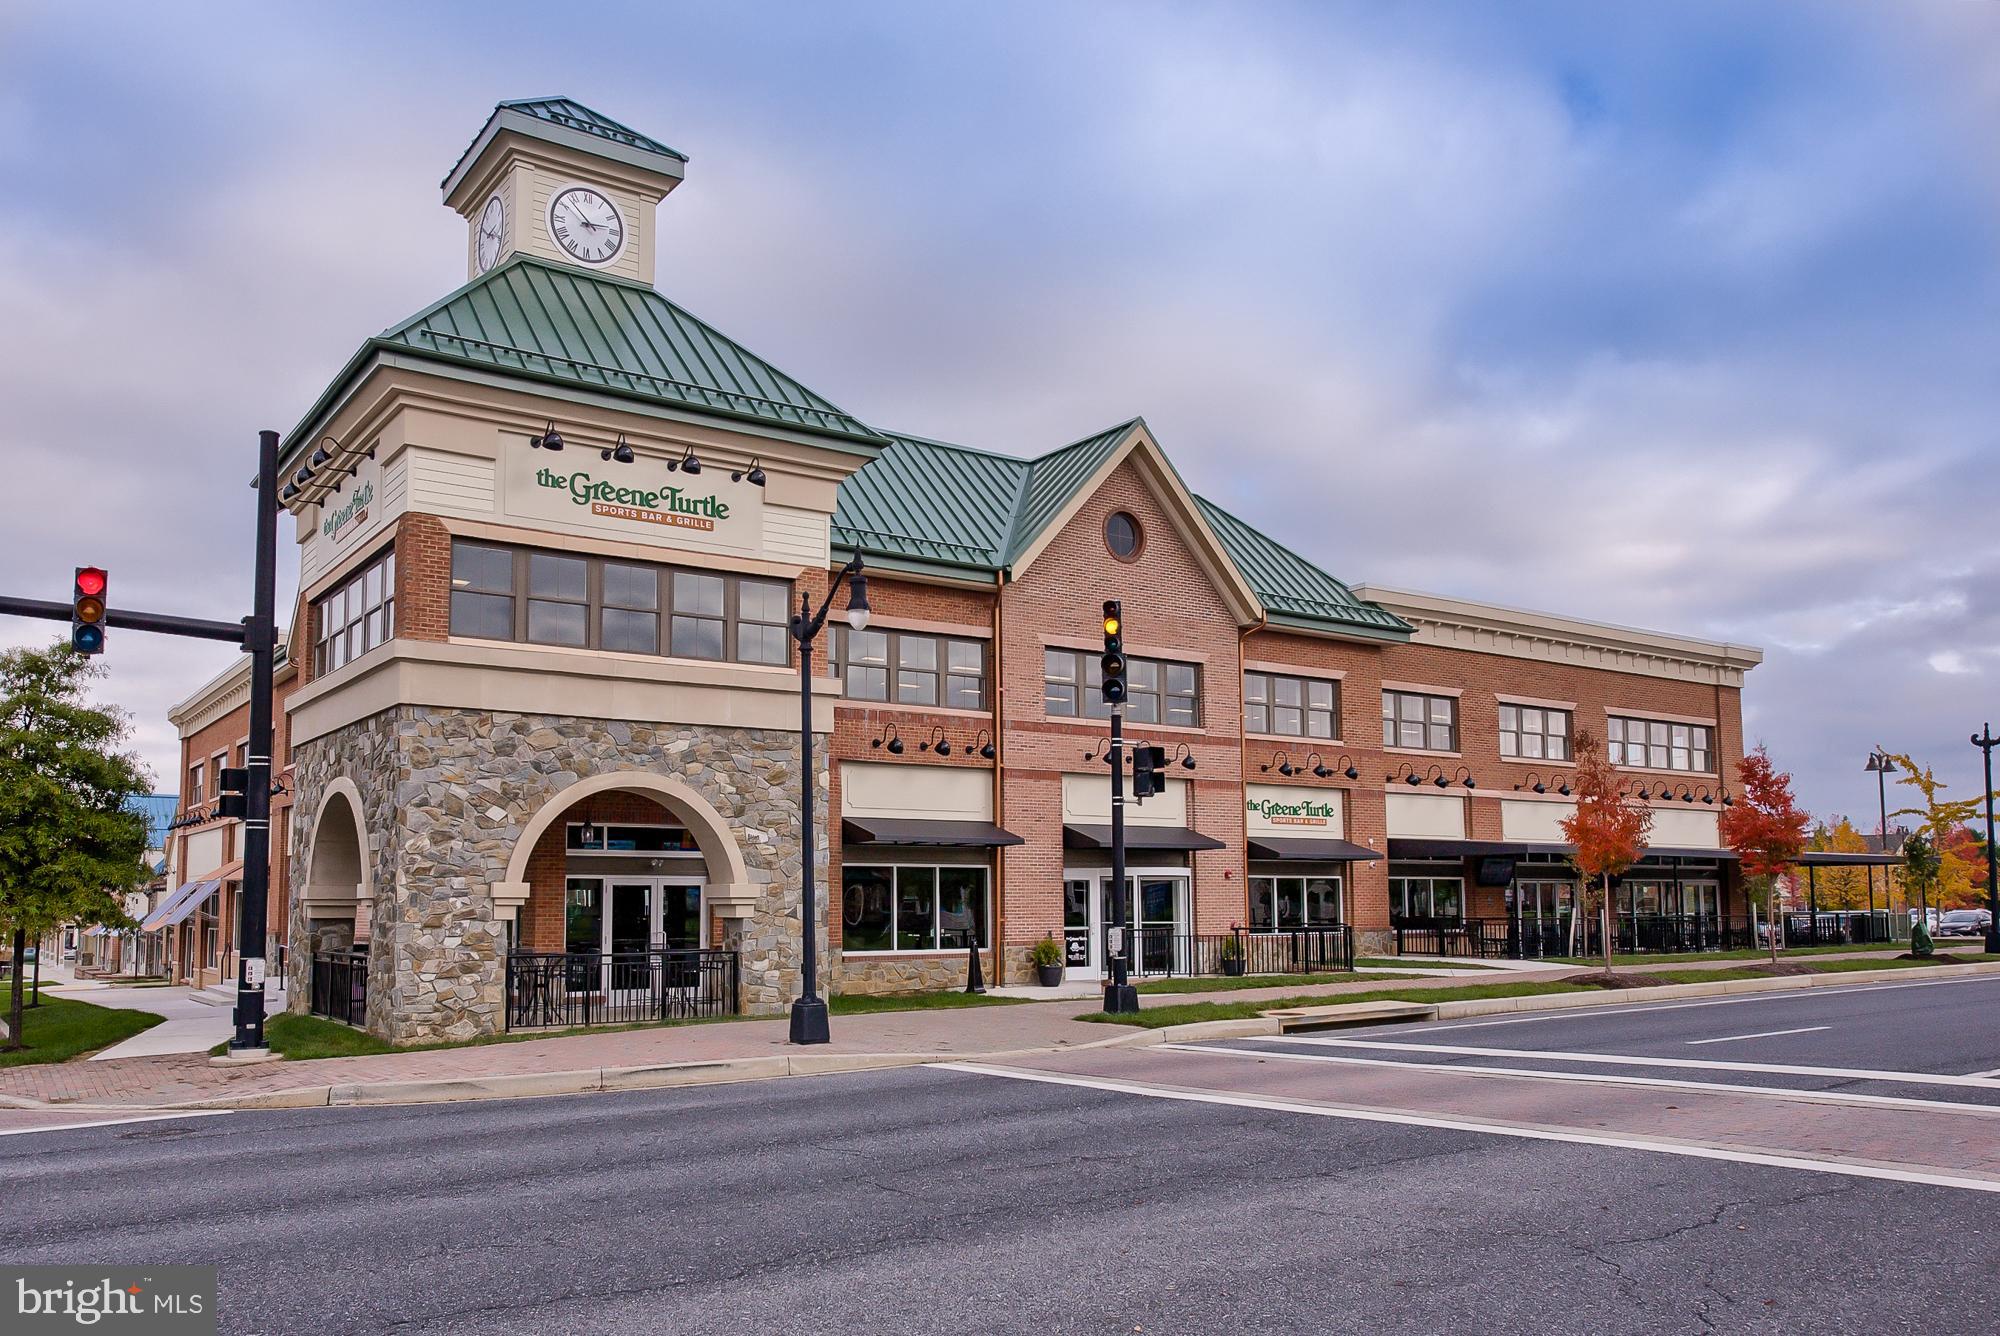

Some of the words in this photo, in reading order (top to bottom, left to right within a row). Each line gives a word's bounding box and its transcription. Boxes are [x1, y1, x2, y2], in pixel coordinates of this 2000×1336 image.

[583, 192, 593, 205] XII
[536, 468, 567, 489] the
[569, 472, 659, 508] Greene
[660, 486, 730, 519] Turtle
[595, 504, 638, 518] SPORTS
[641, 511, 663, 522] BAR
[676, 516, 712, 529] GRILLE
[1247, 799, 1261, 811] the
[1261, 799, 1301, 819] Greene
[1301, 800, 1334, 818] Turtle
